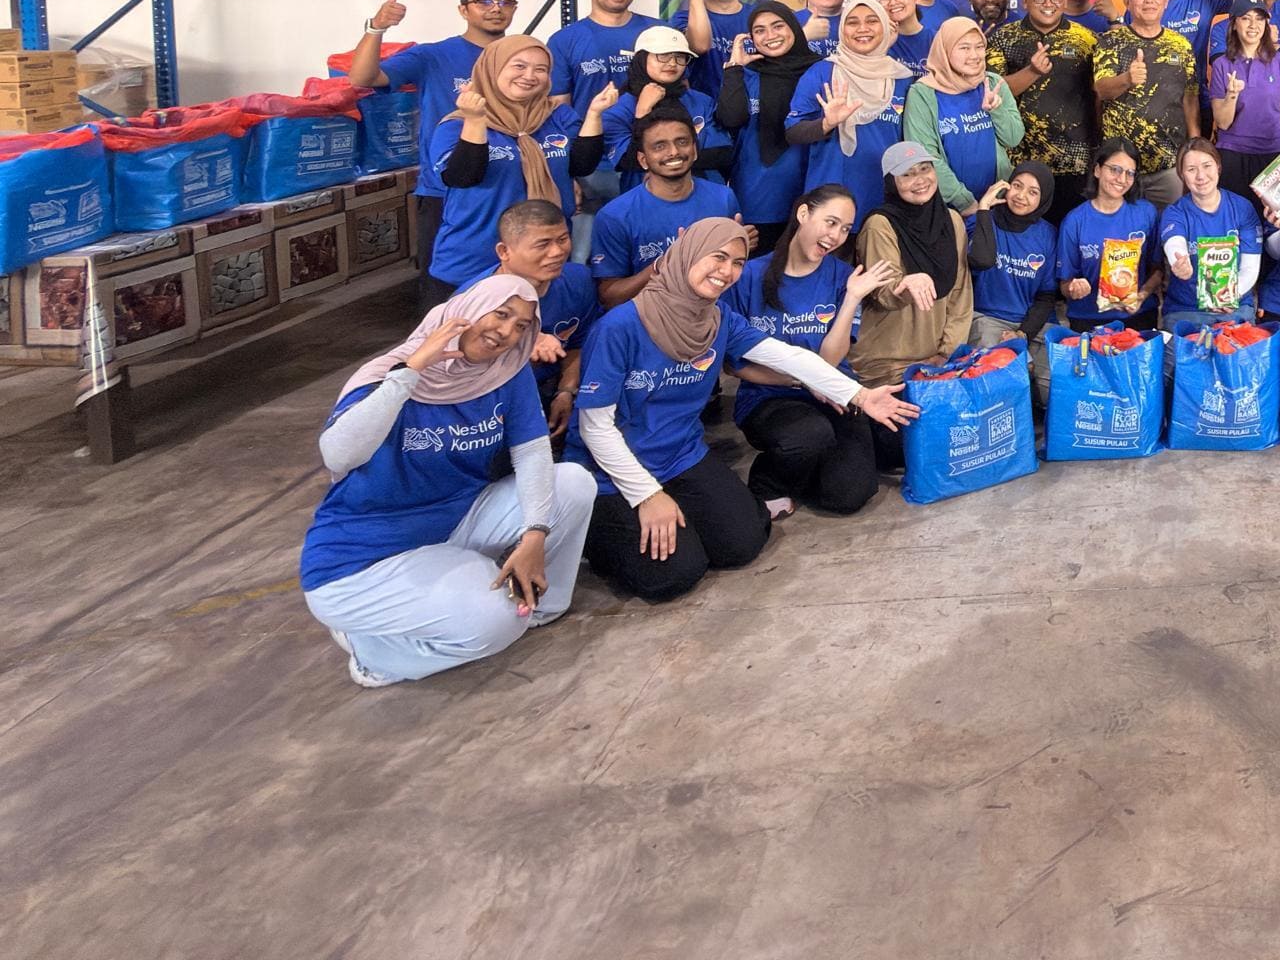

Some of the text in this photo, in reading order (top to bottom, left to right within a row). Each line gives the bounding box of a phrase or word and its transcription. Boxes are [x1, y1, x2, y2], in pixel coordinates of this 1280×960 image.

[546, 151, 567, 159] uniti
[1108, 250, 1138, 261] Nestum
[1207, 253, 1229, 261] MILO
[783, 311, 815, 324] Nestlé
[449, 416, 498, 437] Nestlé
[1084, 438, 1106, 446] SUSUR
[961, 447, 1006, 470] SUSUR PULAU
